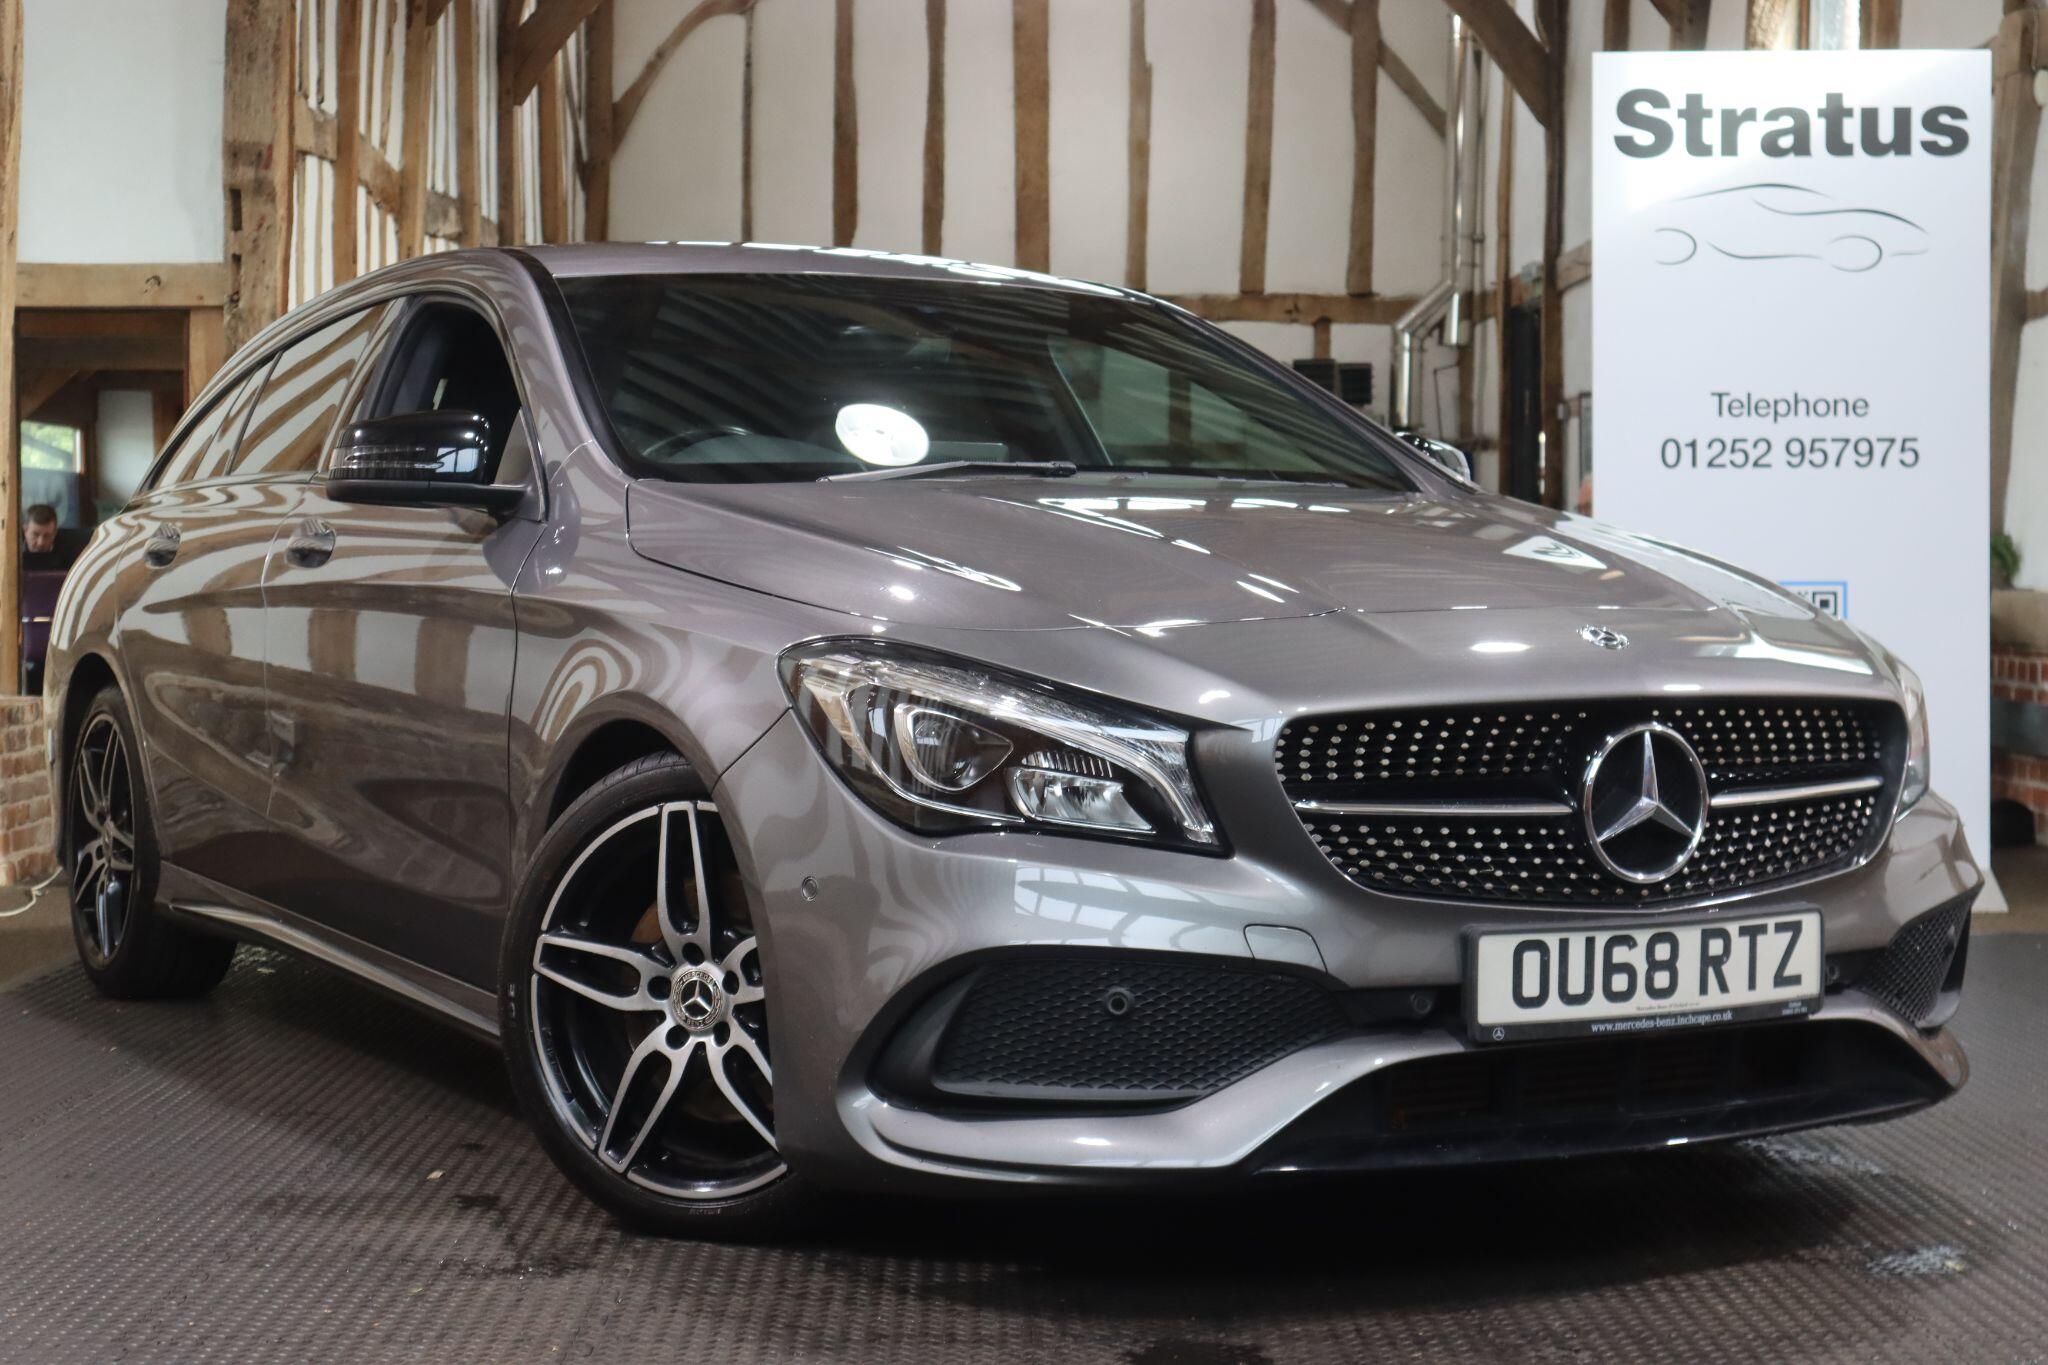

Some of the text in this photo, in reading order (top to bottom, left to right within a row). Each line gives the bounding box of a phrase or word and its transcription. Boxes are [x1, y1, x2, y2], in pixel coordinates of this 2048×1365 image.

[1614, 88, 1970, 159] Stratus
[1712, 392, 1870, 422] Telephone
[1661, 438, 1920, 469] 01252 957975
[1512, 920, 1803, 1009] OU68 RTZ
[1591, 1010, 1733, 1032] www.mercedes-benz.inchcape.co.uk
